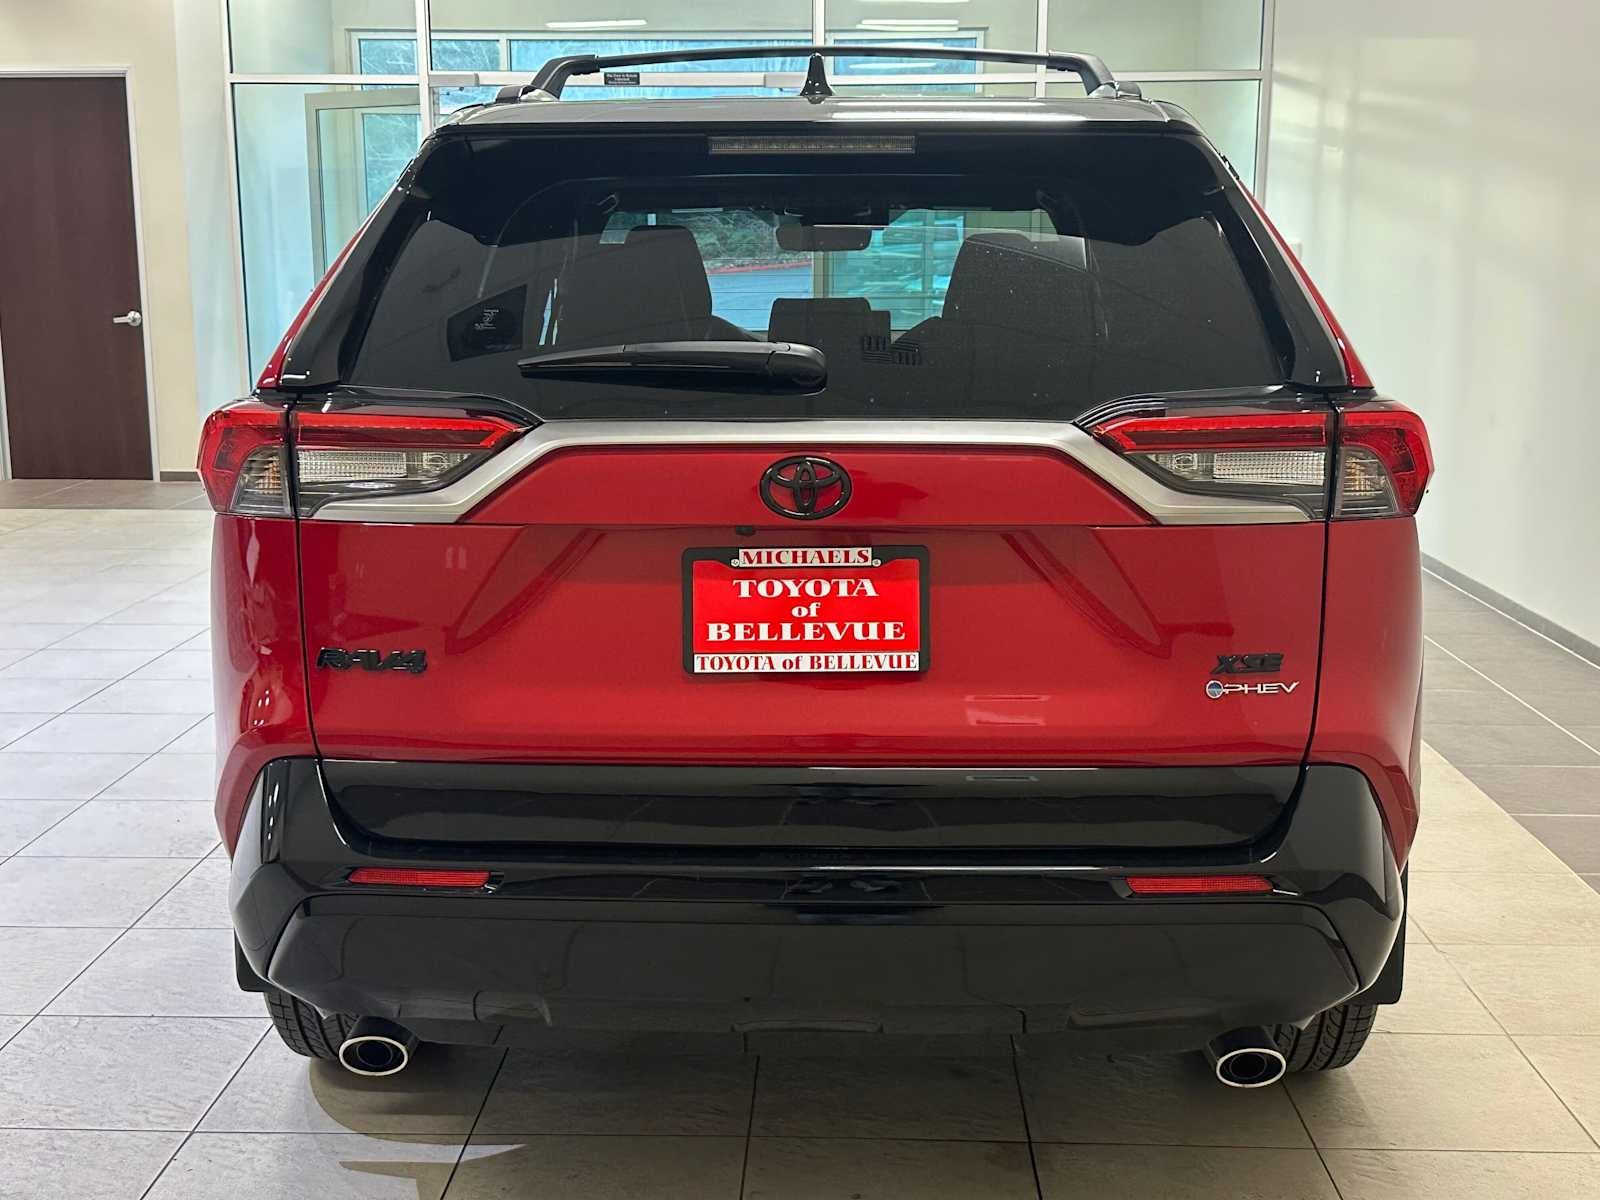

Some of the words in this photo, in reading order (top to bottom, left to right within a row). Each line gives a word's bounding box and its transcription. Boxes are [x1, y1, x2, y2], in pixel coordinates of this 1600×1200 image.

[742, 550, 869, 565] MICHAELS
[733, 579, 879, 598] TOYOTA
[791, 602, 821, 618] of
[706, 622, 906, 642] BELLEVUE
[317, 648, 428, 674] RAV4
[696, 655, 775, 671] TOYOTA
[782, 655, 803, 671] of
[810, 653, 918, 670] BELLEVUE
[1211, 653, 1284, 675] XSE
[1223, 681, 1300, 695] PHEV
